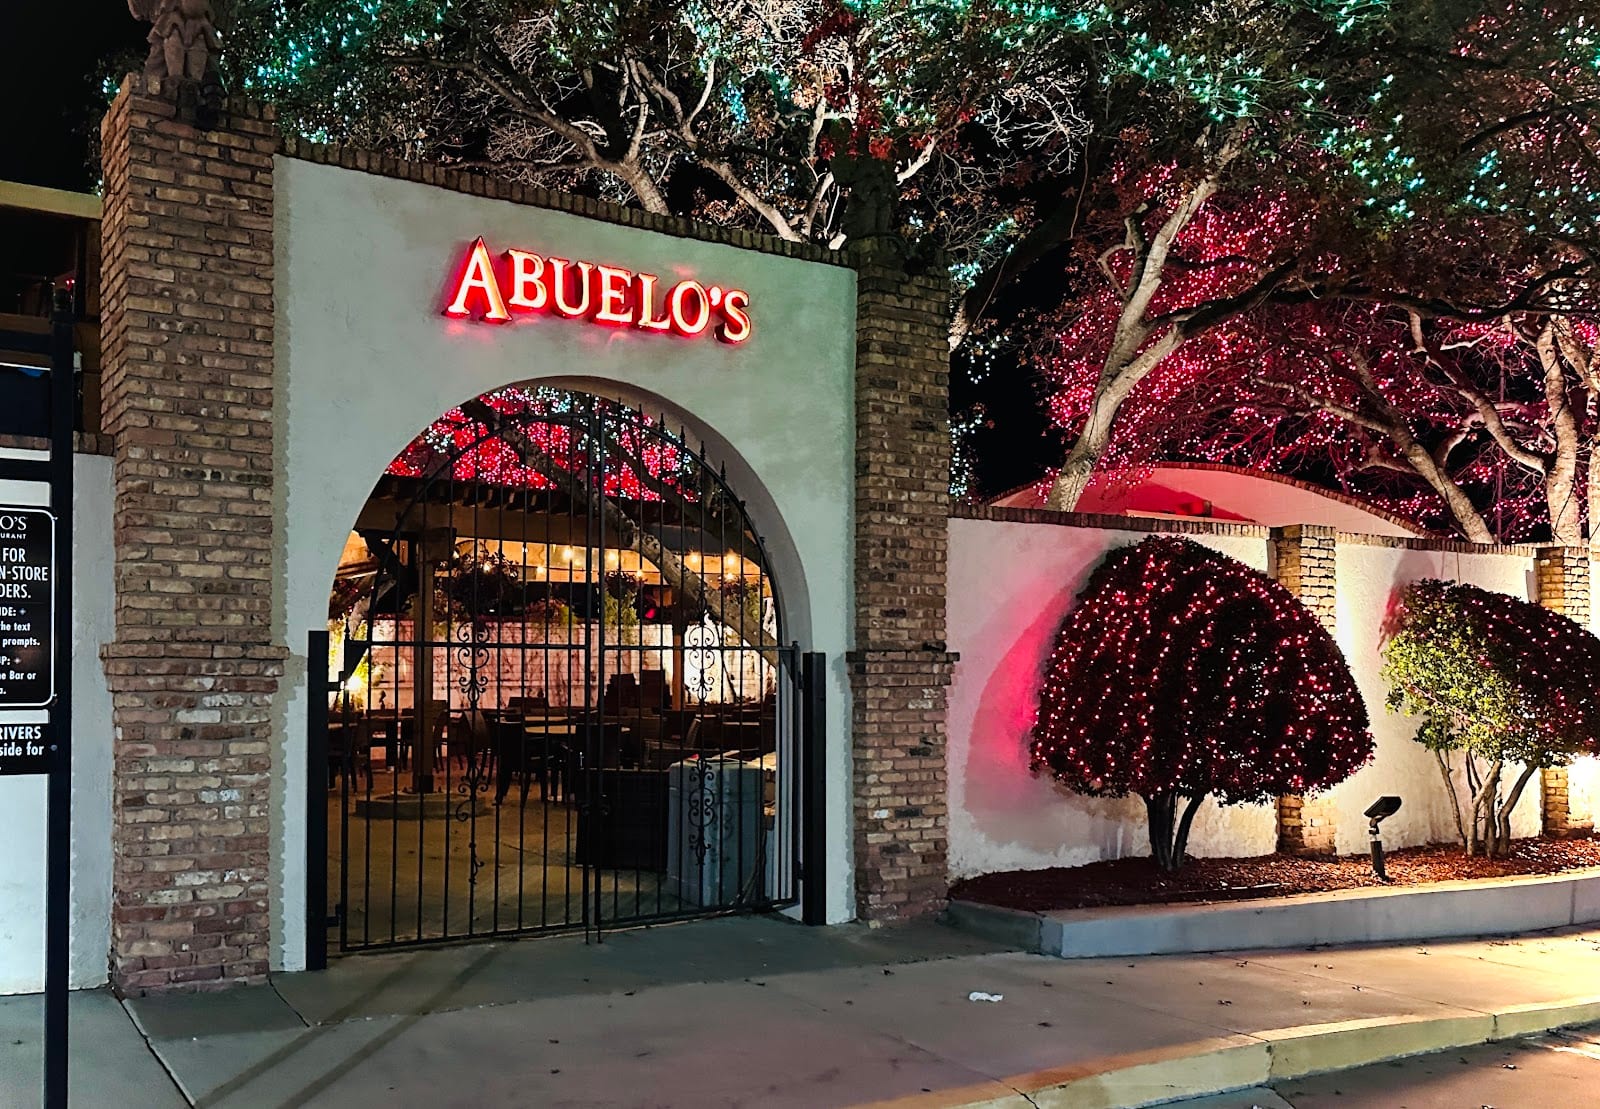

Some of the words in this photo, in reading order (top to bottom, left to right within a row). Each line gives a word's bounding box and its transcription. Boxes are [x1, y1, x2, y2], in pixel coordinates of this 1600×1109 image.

[442, 236, 751, 344] ABUELO'S
[2, 547, 26, 563] FOR
[13, 622, 31, 632] text
[2, 637, 41, 648] prompts.
[9, 670, 25, 680] Bar
[26, 672, 37, 680] or
[26, 741, 45, 756] for
